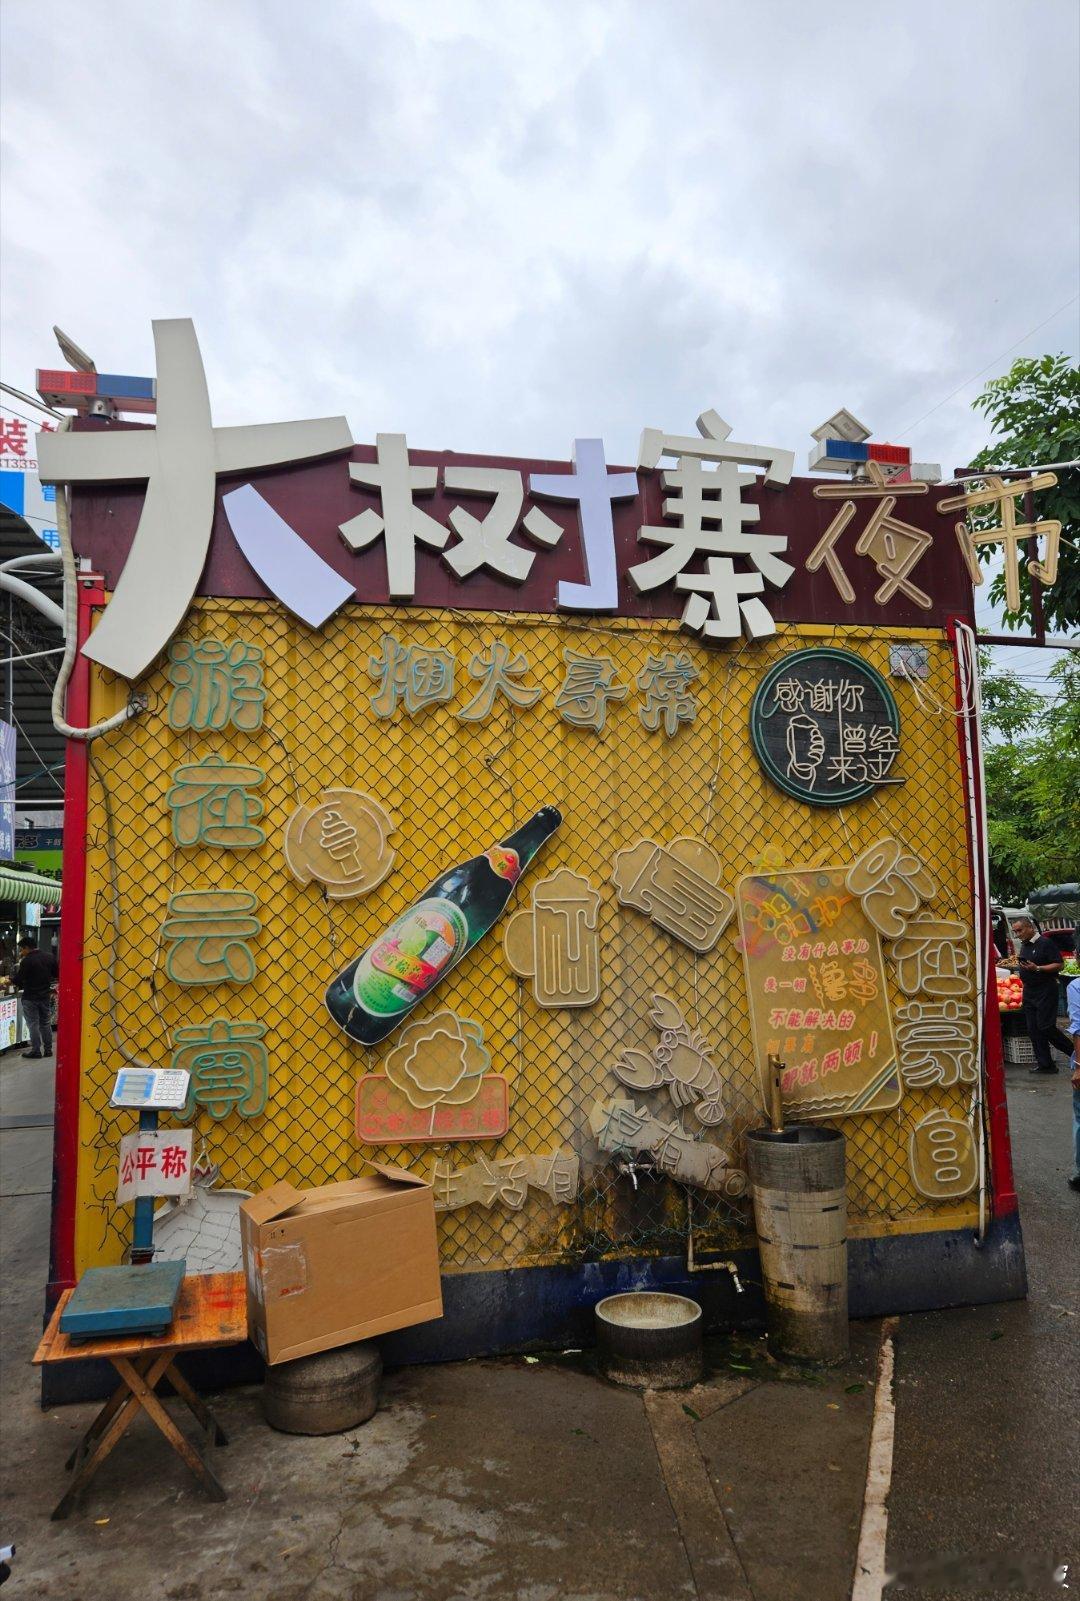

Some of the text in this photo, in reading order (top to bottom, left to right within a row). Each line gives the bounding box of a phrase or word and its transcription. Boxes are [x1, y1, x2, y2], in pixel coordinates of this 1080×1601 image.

[36, 318, 1063, 680] 大树寨 夜市
[368, 634, 700, 739] 烟火寻常
[773, 678, 865, 713] 感谢你
[843, 723, 901, 753] 曾经
[826, 752, 906, 785] 来过
[781, 938, 870, 962] 没有什么事儿
[768, 1007, 856, 1031] 不能解决的
[121, 1145, 188, 1186] 公平称
